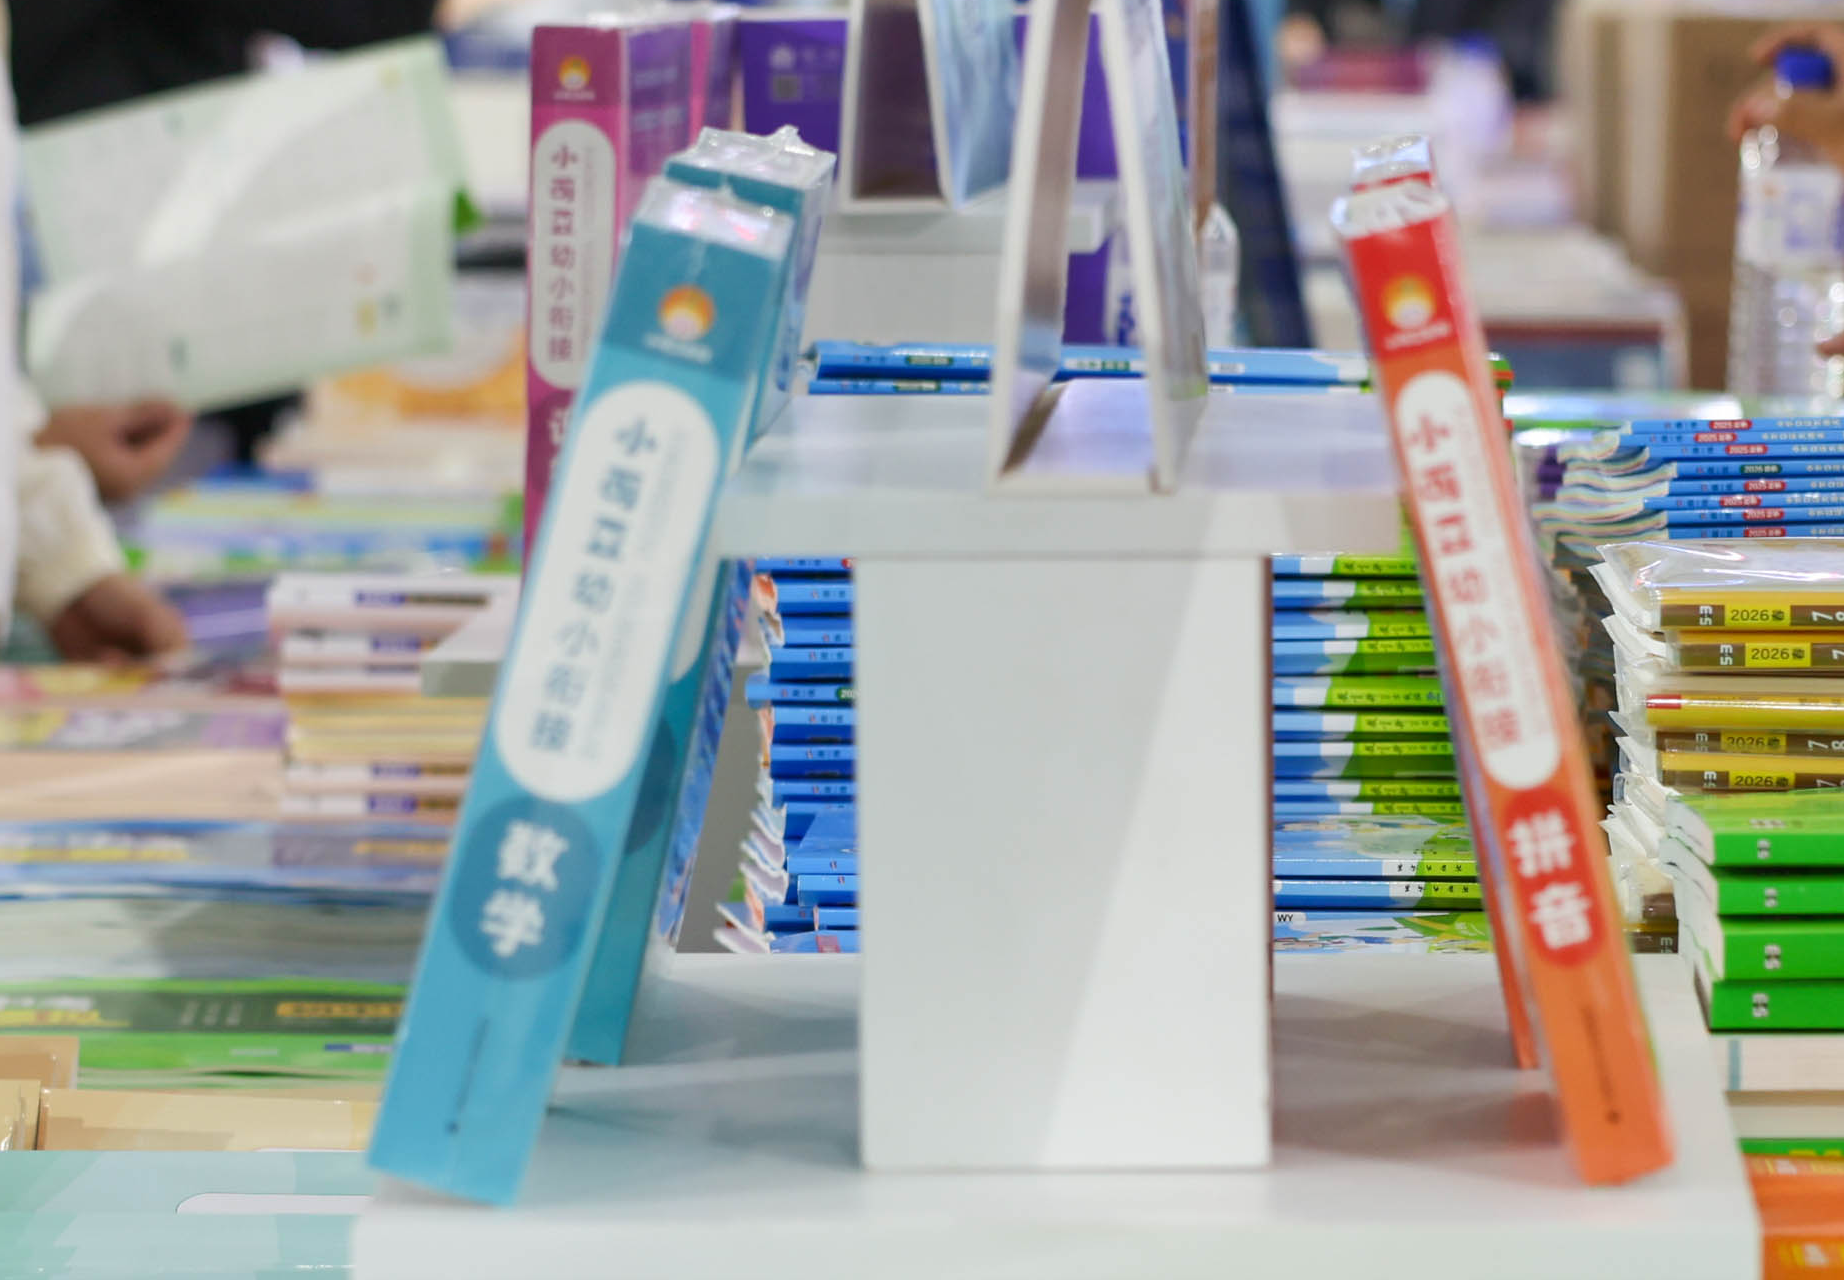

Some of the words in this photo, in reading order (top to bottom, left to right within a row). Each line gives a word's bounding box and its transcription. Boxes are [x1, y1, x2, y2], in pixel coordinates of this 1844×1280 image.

[1699, 605, 1714, 625] 53
[1730, 608, 1786, 622] 2026春
[1719, 644, 1734, 665] 53
[1750, 646, 1806, 661] 2026春
[1726, 735, 1782, 750] 2026春
[1734, 775, 1789, 788] 2026春
[479, 818, 570, 959] 数学
[1505, 813, 1595, 946] 拼音
[1277, 913, 1295, 923] WY
